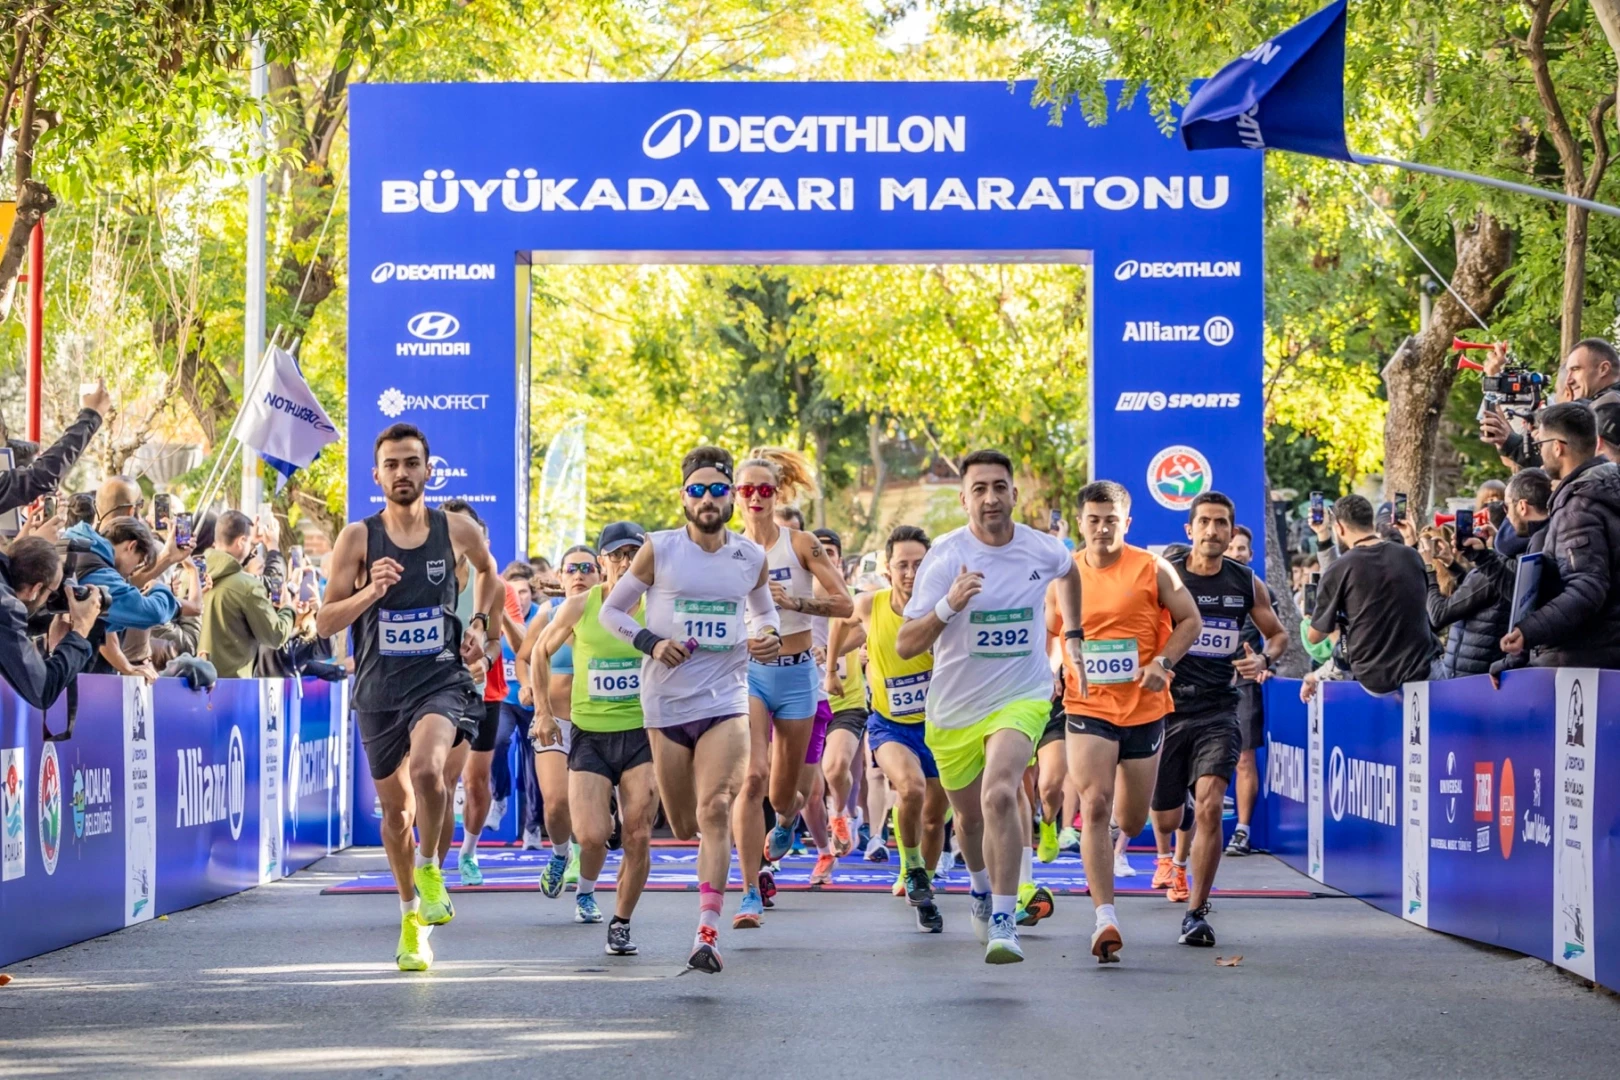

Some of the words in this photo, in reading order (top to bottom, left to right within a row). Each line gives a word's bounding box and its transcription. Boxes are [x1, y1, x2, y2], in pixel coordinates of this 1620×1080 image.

[708, 115, 966, 153] DECATHLON
[381, 168, 710, 213] BÜYÜKADA
[717, 177, 855, 211] YARI
[880, 175, 1229, 211] MARATONU
[396, 264, 495, 281] DECATHLON
[1140, 261, 1240, 278] DECATHLON
[1122, 321, 1200, 342] Allianz
[396, 342, 470, 356] HYUNDAI
[406, 394, 489, 410] PANOFFECT
[1168, 393, 1240, 408] SPORTS
[385, 626, 439, 645] 5484
[684, 620, 727, 639] 1115
[977, 628, 1029, 647] 2392
[1086, 657, 1134, 674] 2069
[593, 674, 640, 691] 1063
[892, 688, 928, 706] 534
[85, 767, 112, 805] ADALAR
[176, 747, 227, 829] Allianz
[1347, 757, 1397, 827] HYUNDAI
